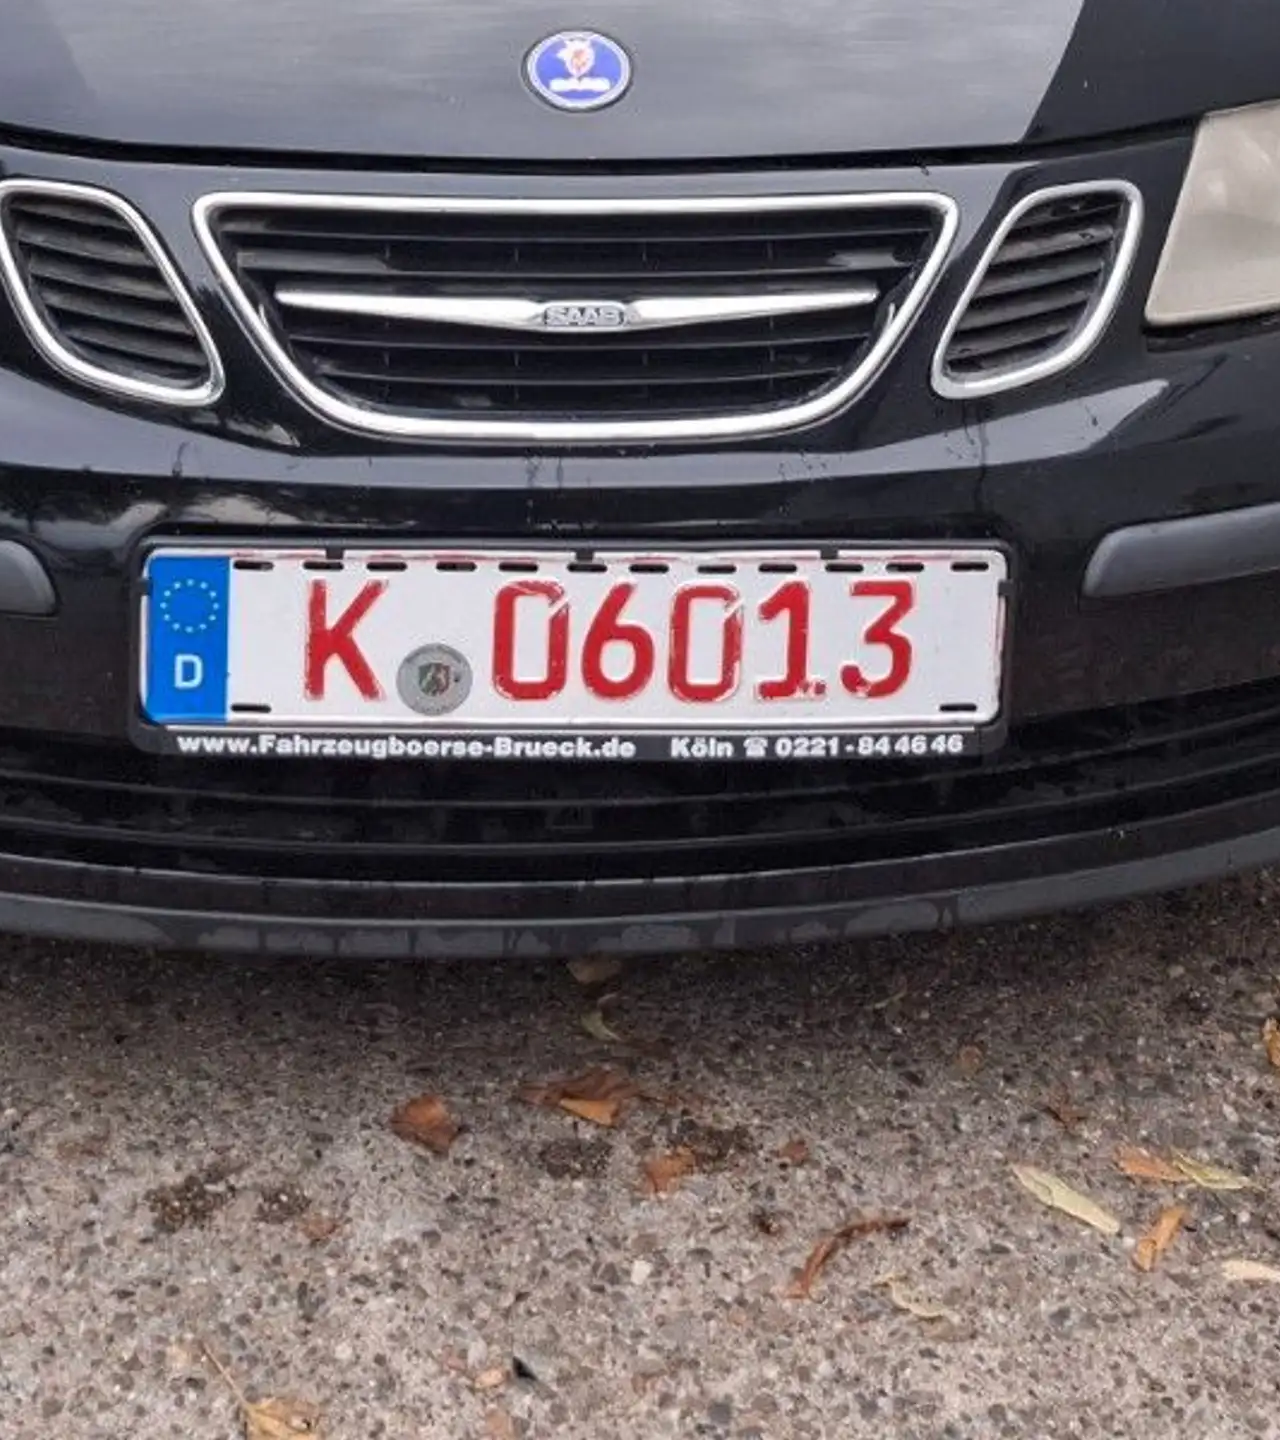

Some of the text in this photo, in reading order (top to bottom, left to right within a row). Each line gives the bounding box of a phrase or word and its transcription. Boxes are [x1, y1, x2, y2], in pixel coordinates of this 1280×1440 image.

[303, 577, 918, 703] K 06013
[174, 653, 204, 689] D
[177, 734, 637, 759] www.Fahrzeugboerse-Brueck.de
[671, 737, 734, 758] Köln
